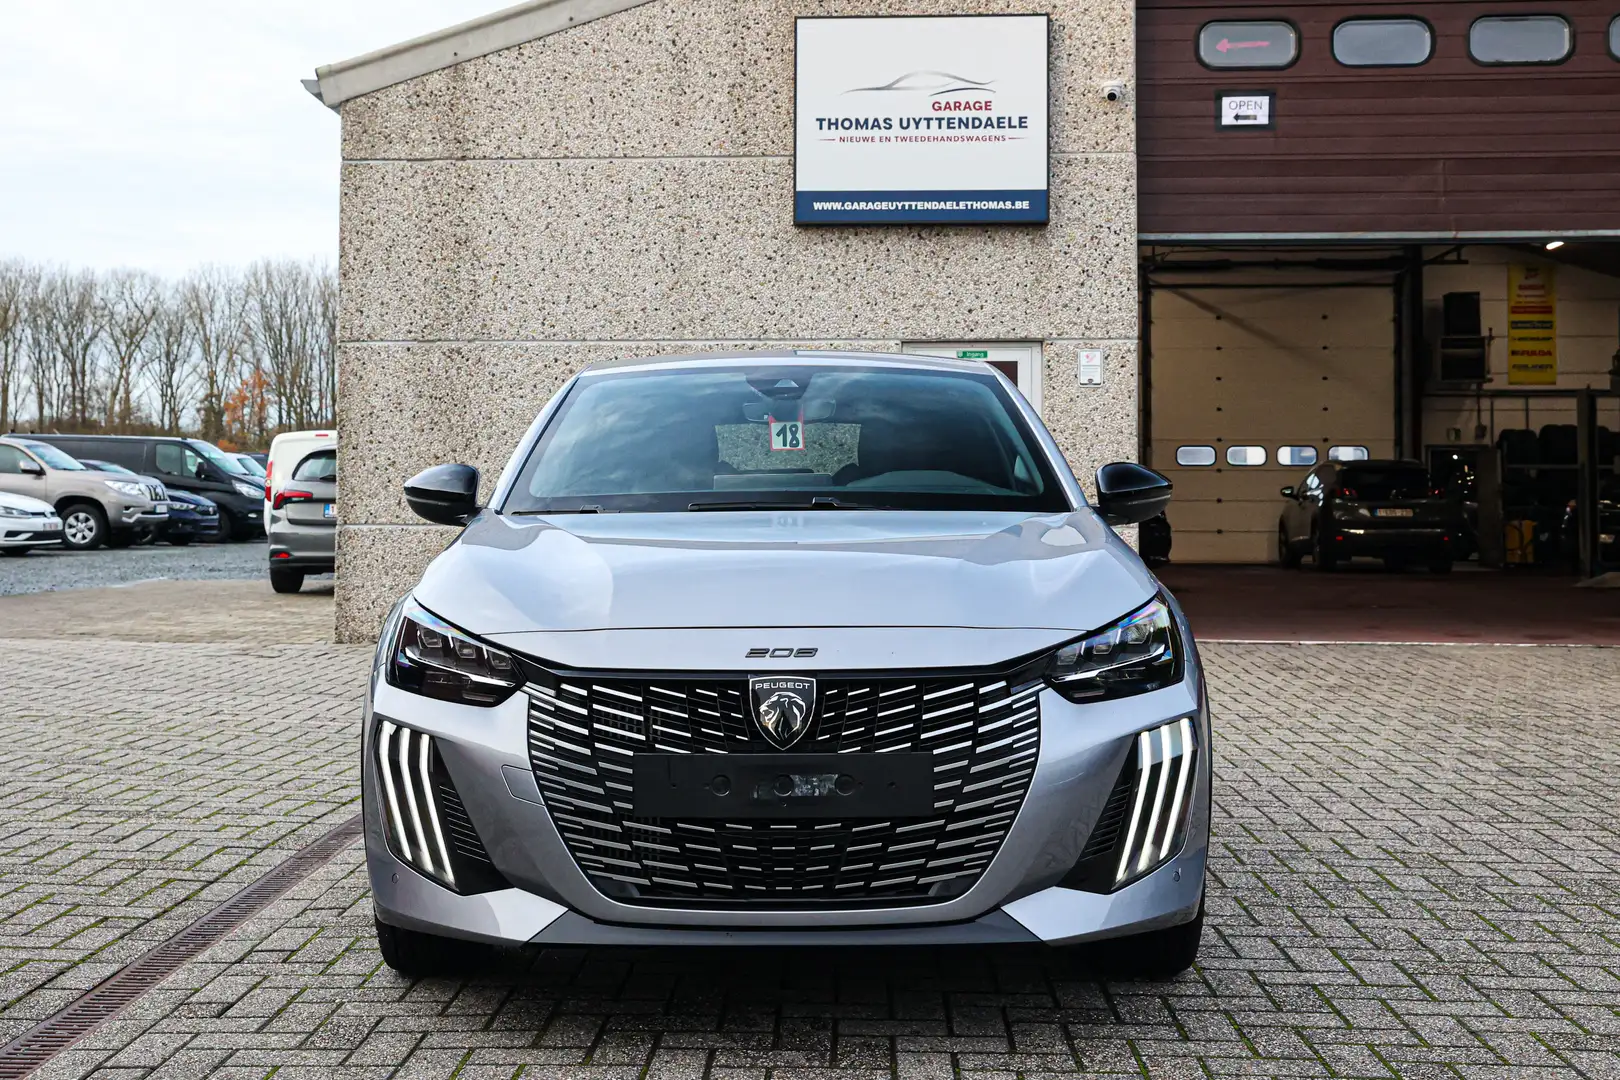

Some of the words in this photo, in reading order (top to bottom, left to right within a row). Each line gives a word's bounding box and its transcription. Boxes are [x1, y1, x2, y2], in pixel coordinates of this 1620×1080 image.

[931, 100, 993, 112] GARAGE
[1229, 100, 1263, 110] OPEN
[816, 117, 893, 131] THOMAS
[899, 116, 1029, 130] UYTTENDAELE
[879, 135, 892, 143] EN
[894, 134, 1007, 143] TWEEDEHANDSWAGENS
[813, 200, 1030, 211] WWW.GARAGEUYTTENDAELETHOMAS.BE
[966, 351, 984, 359] Ingang
[775, 423, 801, 448] 18
[745, 647, 819, 658] 208
[755, 681, 811, 690] PEUGEOT
